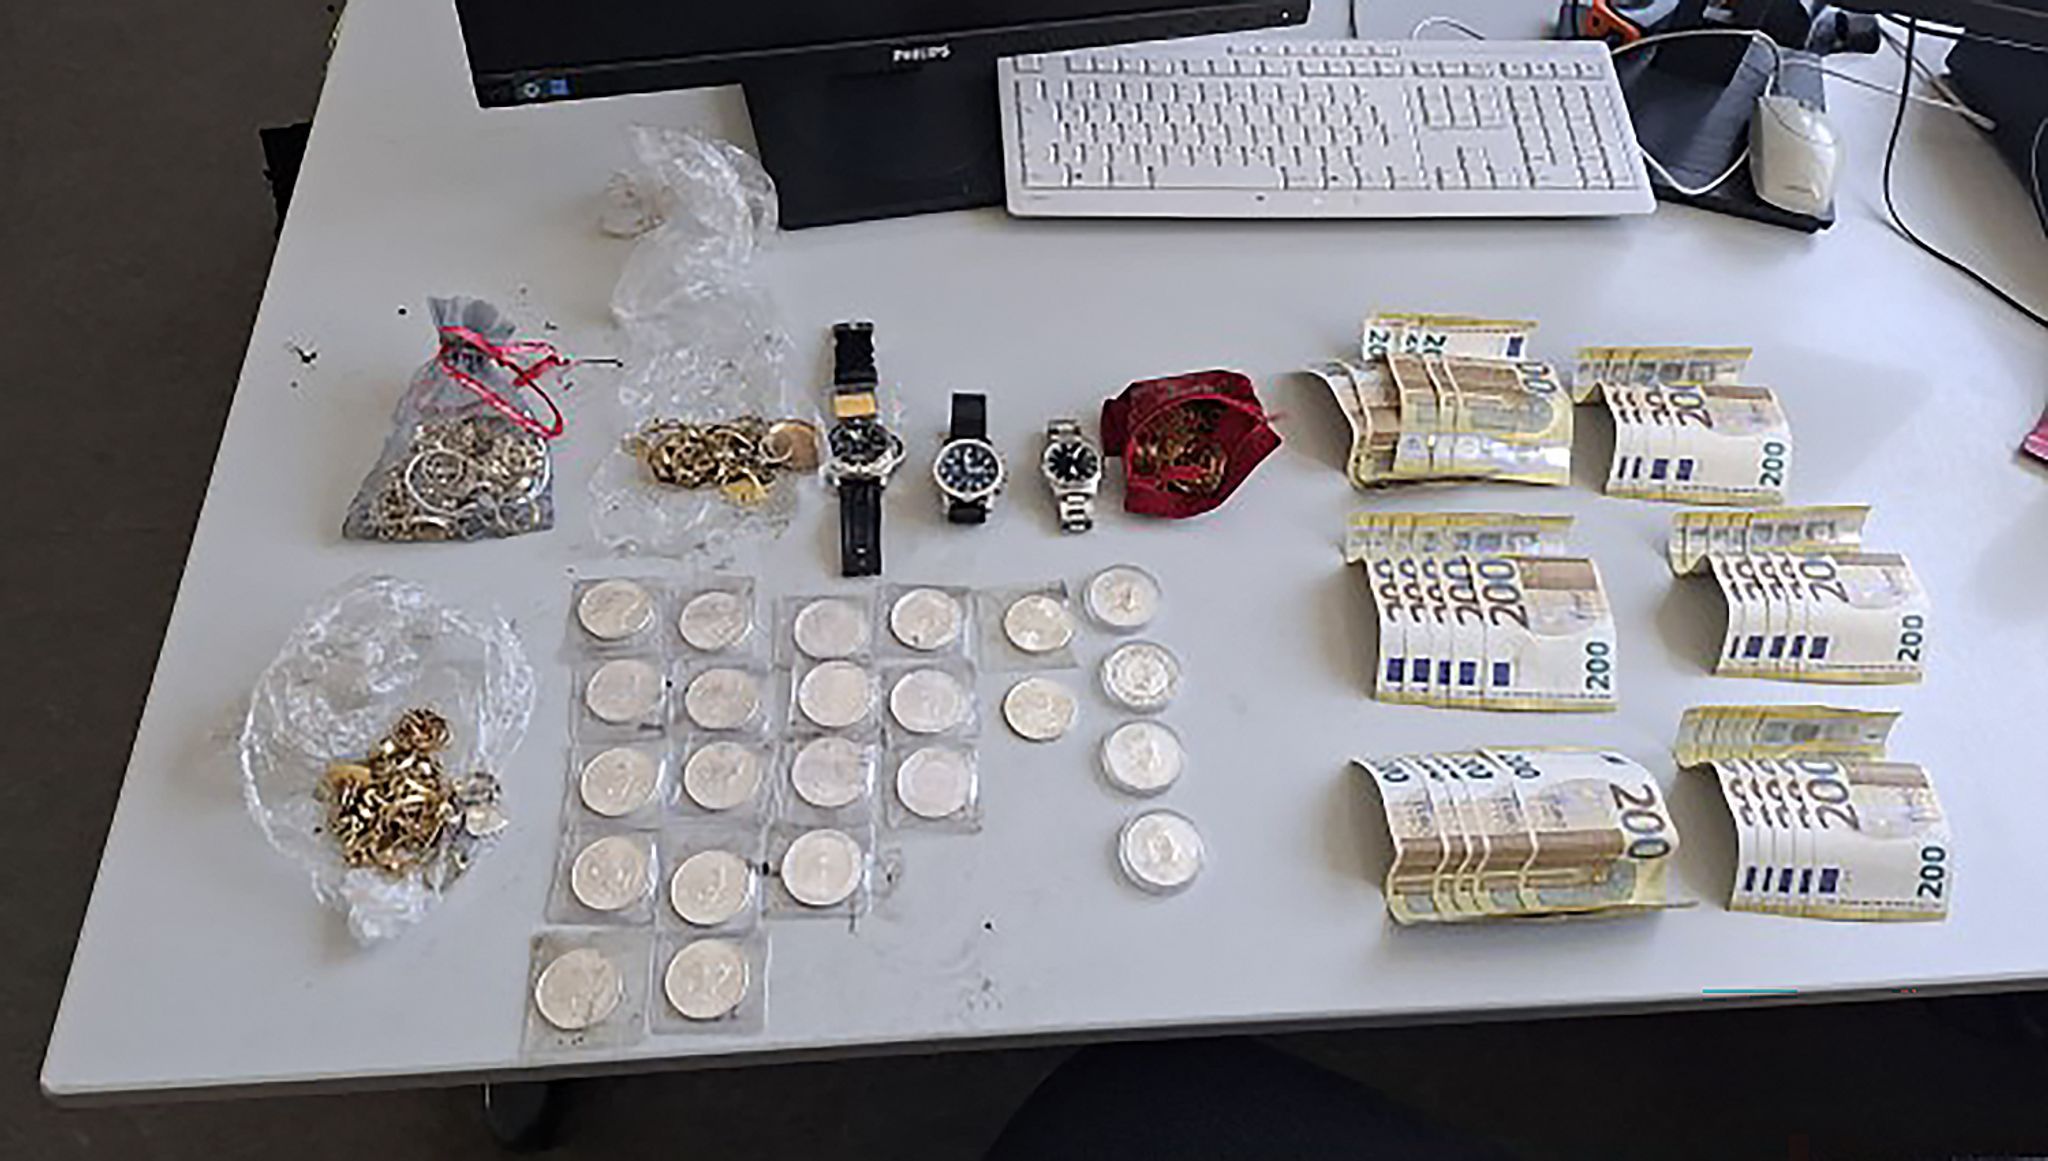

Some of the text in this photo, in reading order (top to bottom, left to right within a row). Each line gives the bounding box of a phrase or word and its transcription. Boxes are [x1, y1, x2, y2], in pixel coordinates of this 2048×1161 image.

[1760, 441, 1786, 487] 200
[1477, 559, 1531, 631] 200
[1898, 614, 1924, 662] 200
[1585, 641, 1611, 691] 200
[1610, 783, 1671, 860] 200
[1917, 845, 1946, 899] 200
